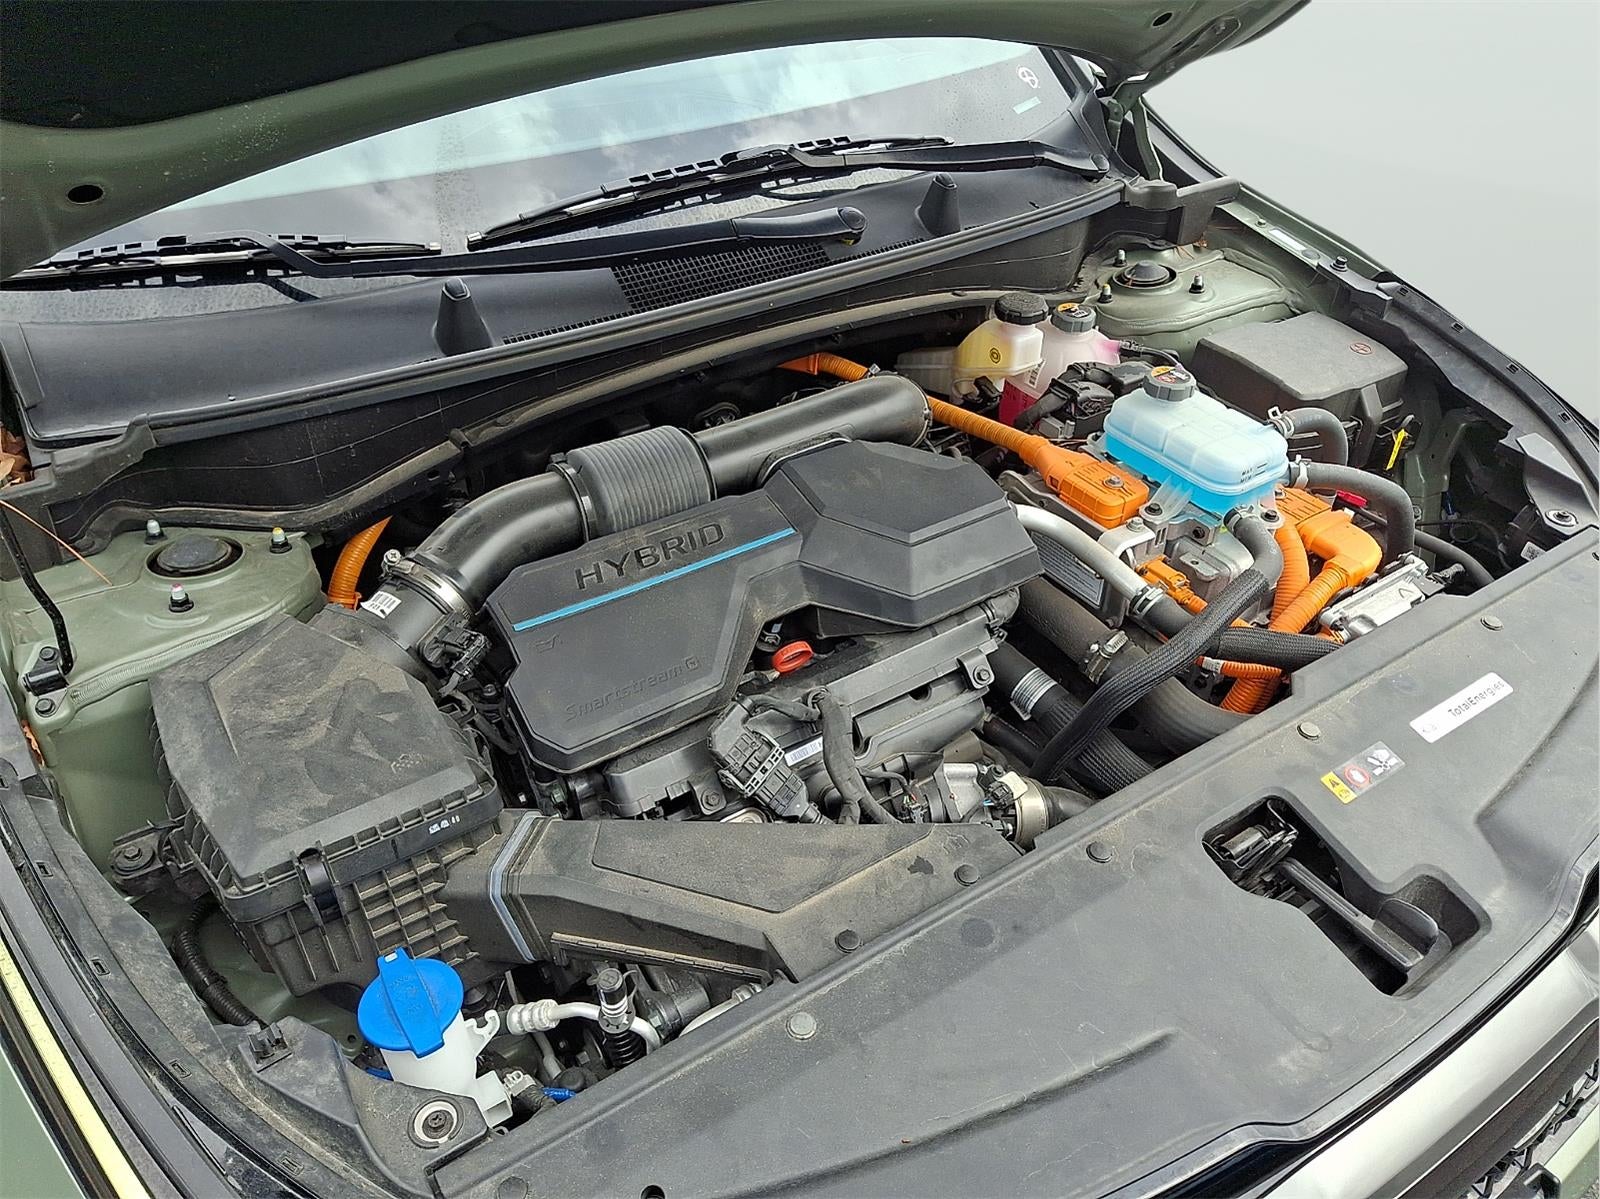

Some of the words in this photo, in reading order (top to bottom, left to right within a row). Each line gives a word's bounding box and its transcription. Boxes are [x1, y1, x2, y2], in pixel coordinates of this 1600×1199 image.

[575, 522, 724, 590] HYBRID
[565, 664, 683, 722] Smartstream
[1447, 680, 1505, 717] TotalEnergies
